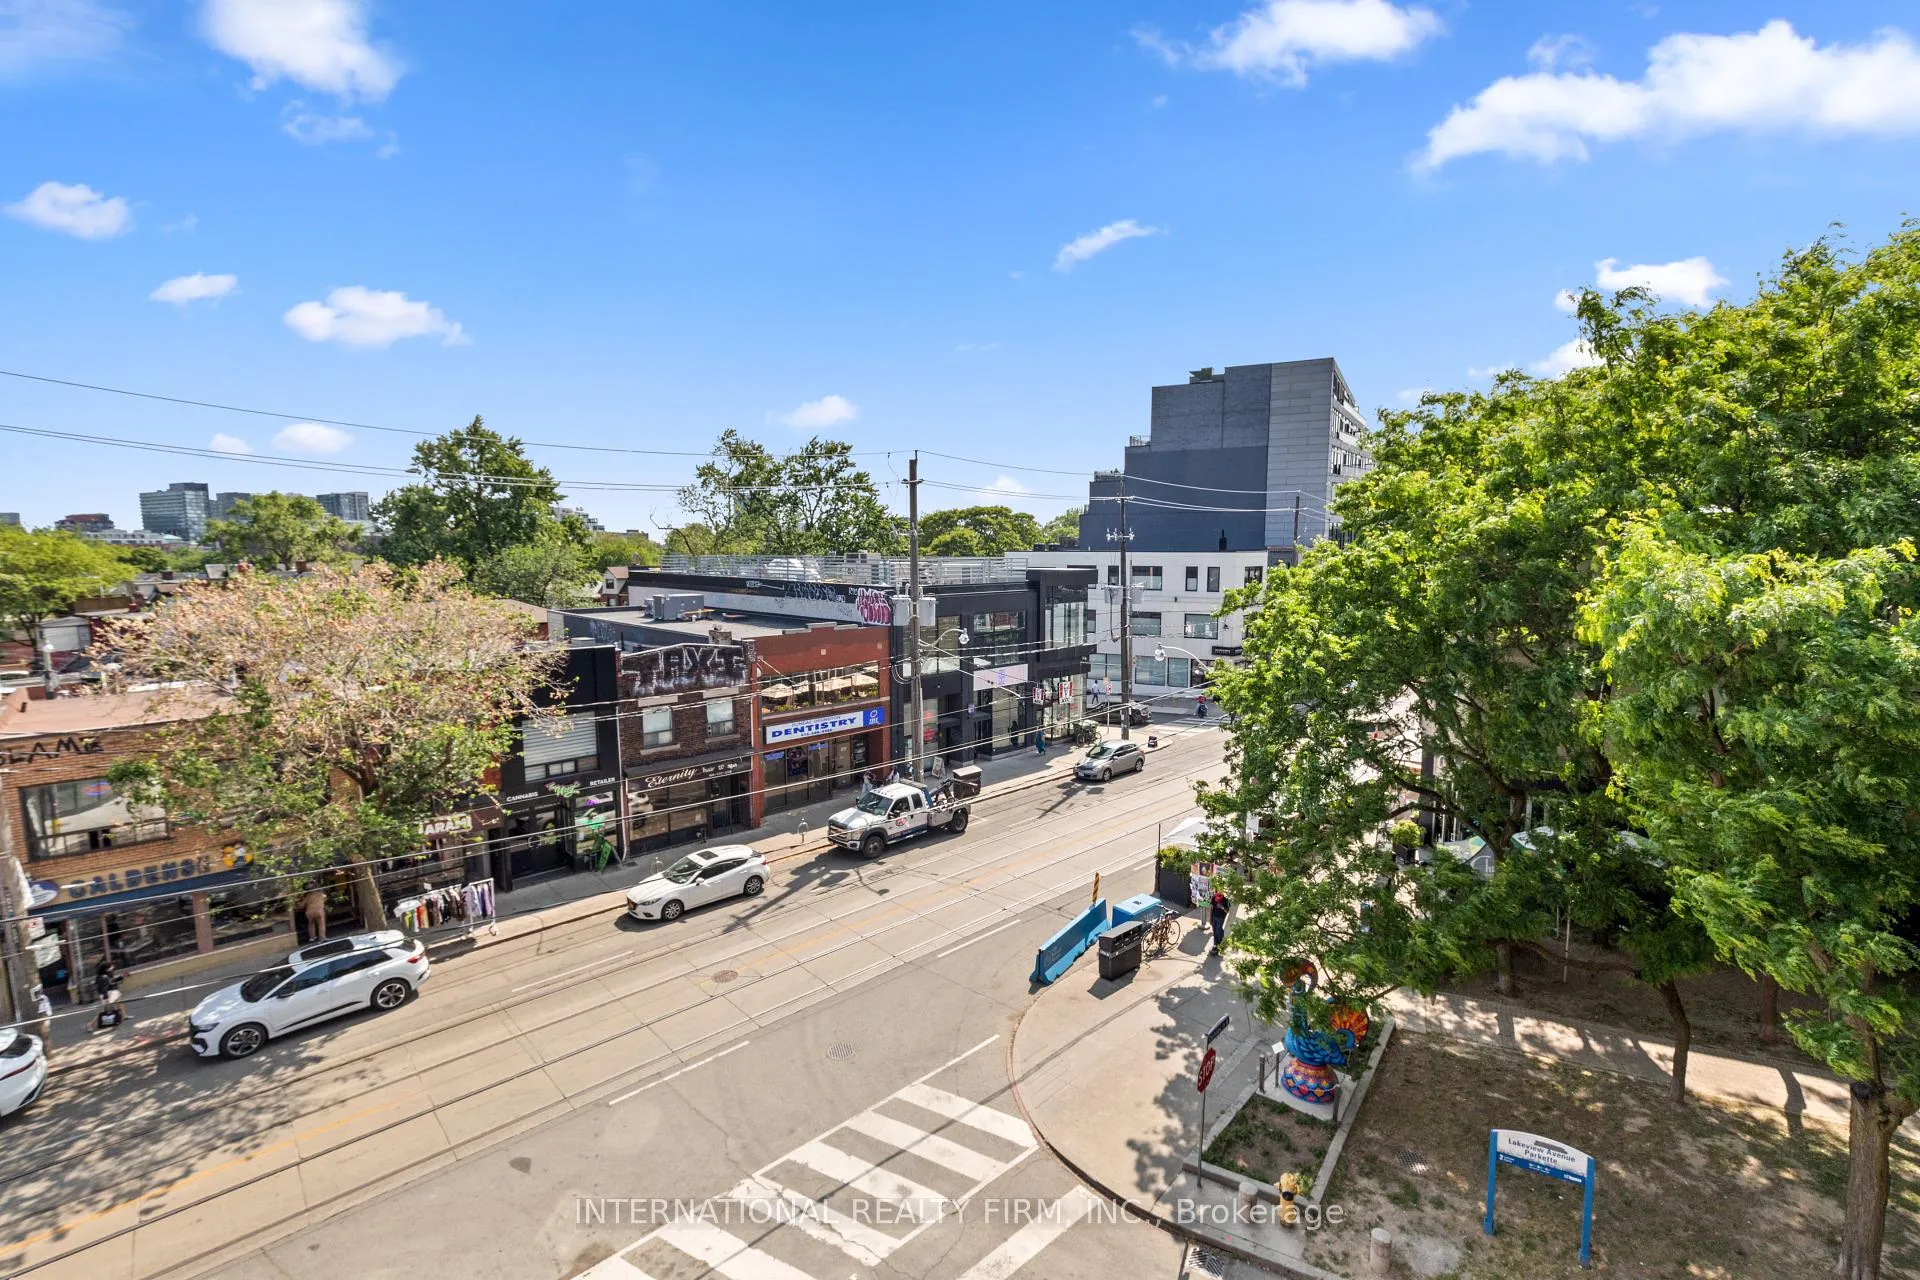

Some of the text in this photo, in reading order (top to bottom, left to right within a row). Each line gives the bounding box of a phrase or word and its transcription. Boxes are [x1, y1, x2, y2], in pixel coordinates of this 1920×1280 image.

[771, 716, 857, 738] DENTISTRY
[589, 776, 616, 787] RETAILER
[645, 768, 698, 788] Eternity
[727, 762, 738, 770] spa
[506, 791, 539, 802] CANNABIS
[1198, 1055, 1215, 1087] STOP
[1508, 1138, 1576, 1163] Lakeview Avenue
[1524, 1149, 1558, 1165] Parkette
